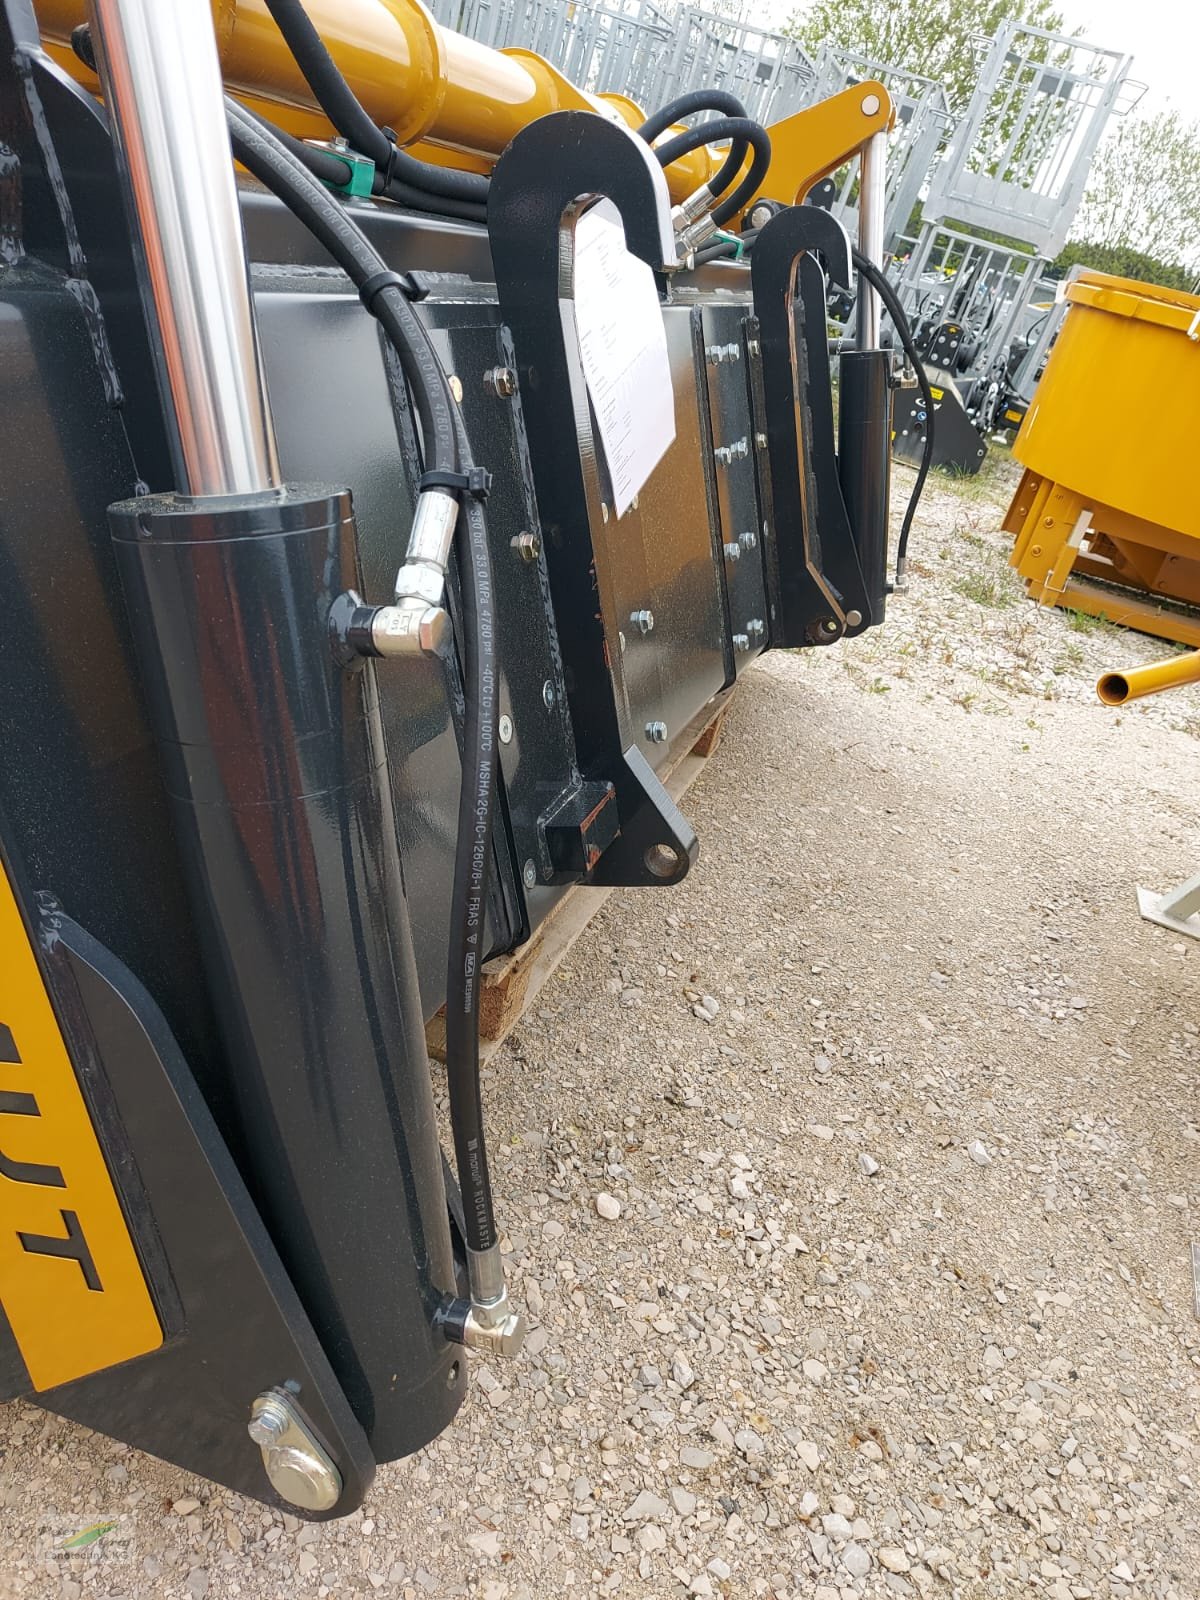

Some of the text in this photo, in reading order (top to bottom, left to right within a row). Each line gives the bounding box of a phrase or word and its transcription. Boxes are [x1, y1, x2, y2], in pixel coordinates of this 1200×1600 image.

[264, 150, 286, 171] SAE
[285, 168, 321, 204] 100R16
[336, 222, 351, 238] 10
[394, 303, 410, 322] 330
[406, 324, 420, 341] bar
[416, 347, 433, 371] 33.0
[424, 373, 440, 398] MPa
[435, 403, 449, 431] 4780
[440, 433, 450, 449] psi
[471, 510, 482, 529] 330
[473, 532, 484, 550] bar
[476, 554, 488, 578] 33.0
[479, 583, 490, 604] MPa
[480, 609, 492, 638] 4780
[483, 641, 493, 655] psi
[482, 696, 493, 708] to
[478, 761, 491, 797] MSHA
[467, 897, 480, 926] FRAS
